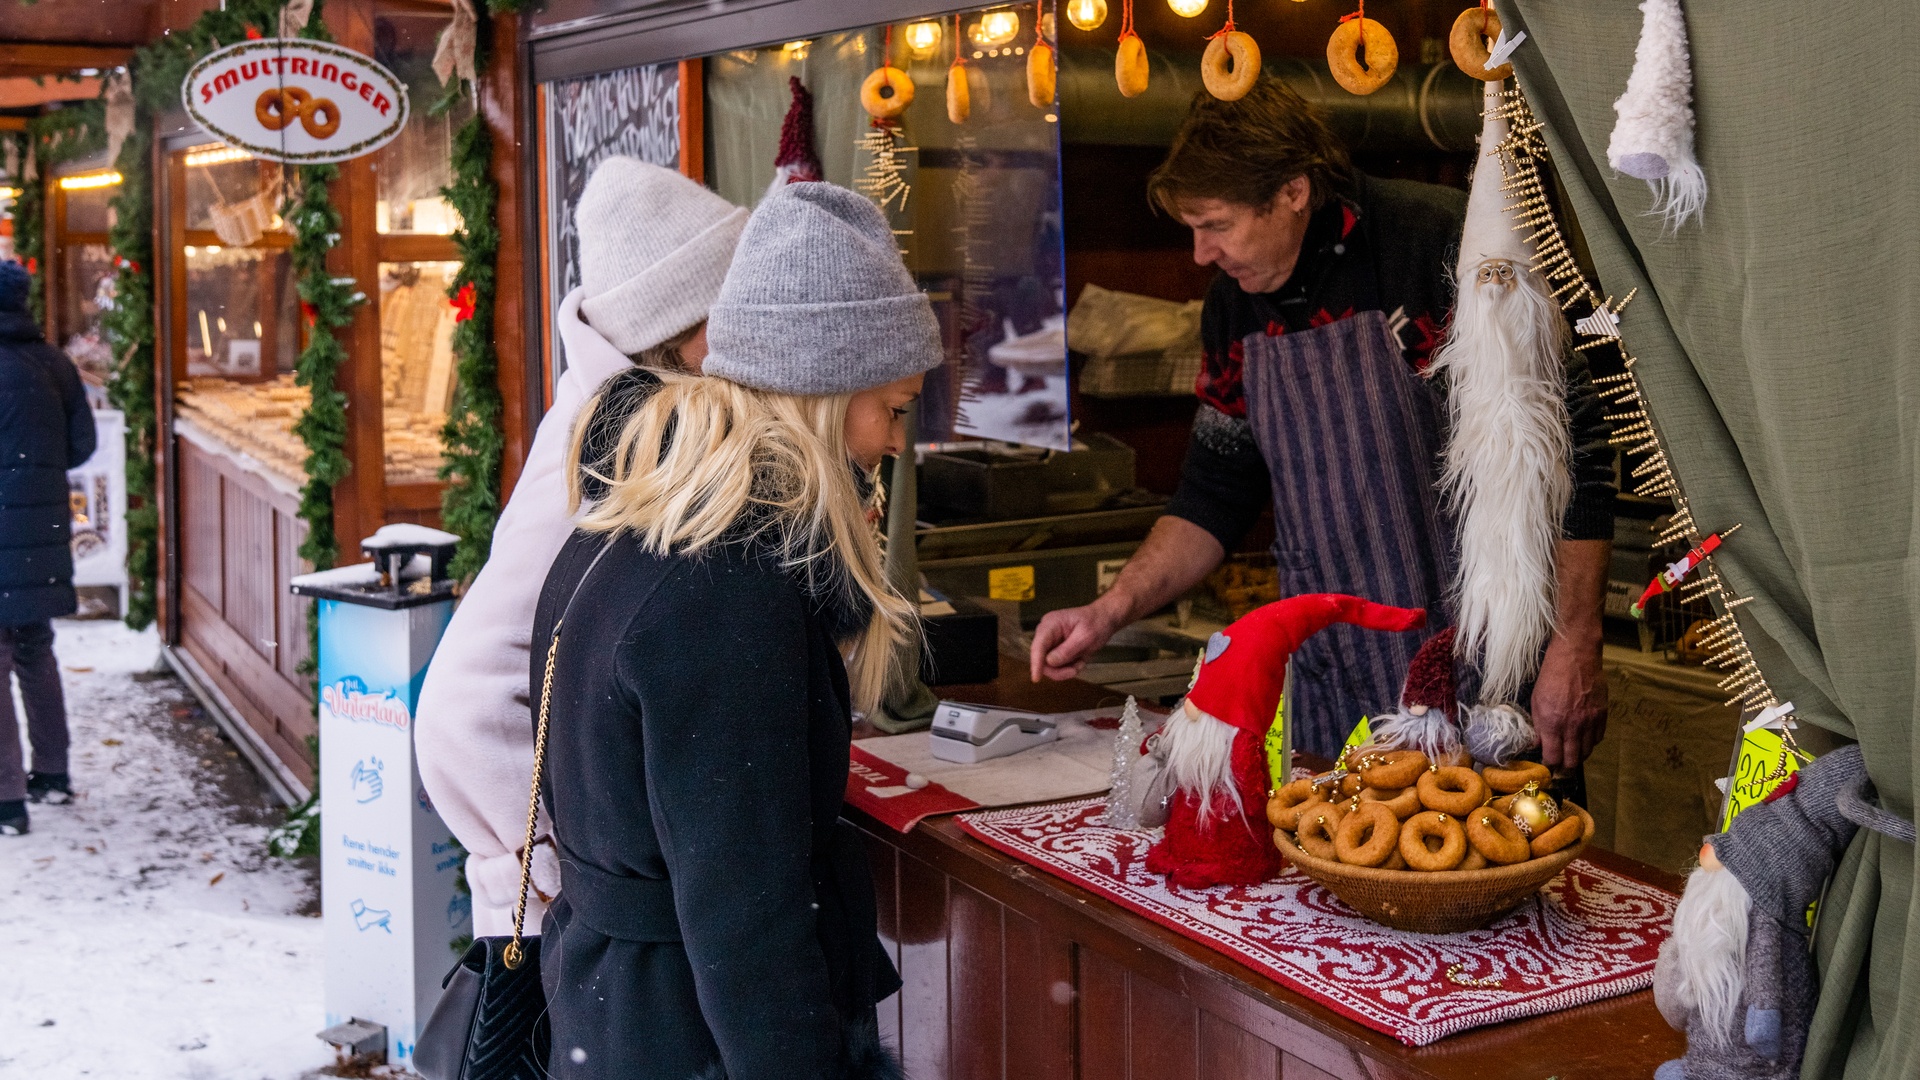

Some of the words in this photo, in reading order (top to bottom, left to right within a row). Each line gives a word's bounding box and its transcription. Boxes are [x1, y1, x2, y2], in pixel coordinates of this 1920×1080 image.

[201, 57, 391, 117] SMULTRINGER
[323, 681, 408, 730] Vinterland
[342, 834, 365, 851] Rene
[368, 840, 400, 859] hender
[347, 857, 375, 872] smitter
[378, 860, 396, 876] ikke
